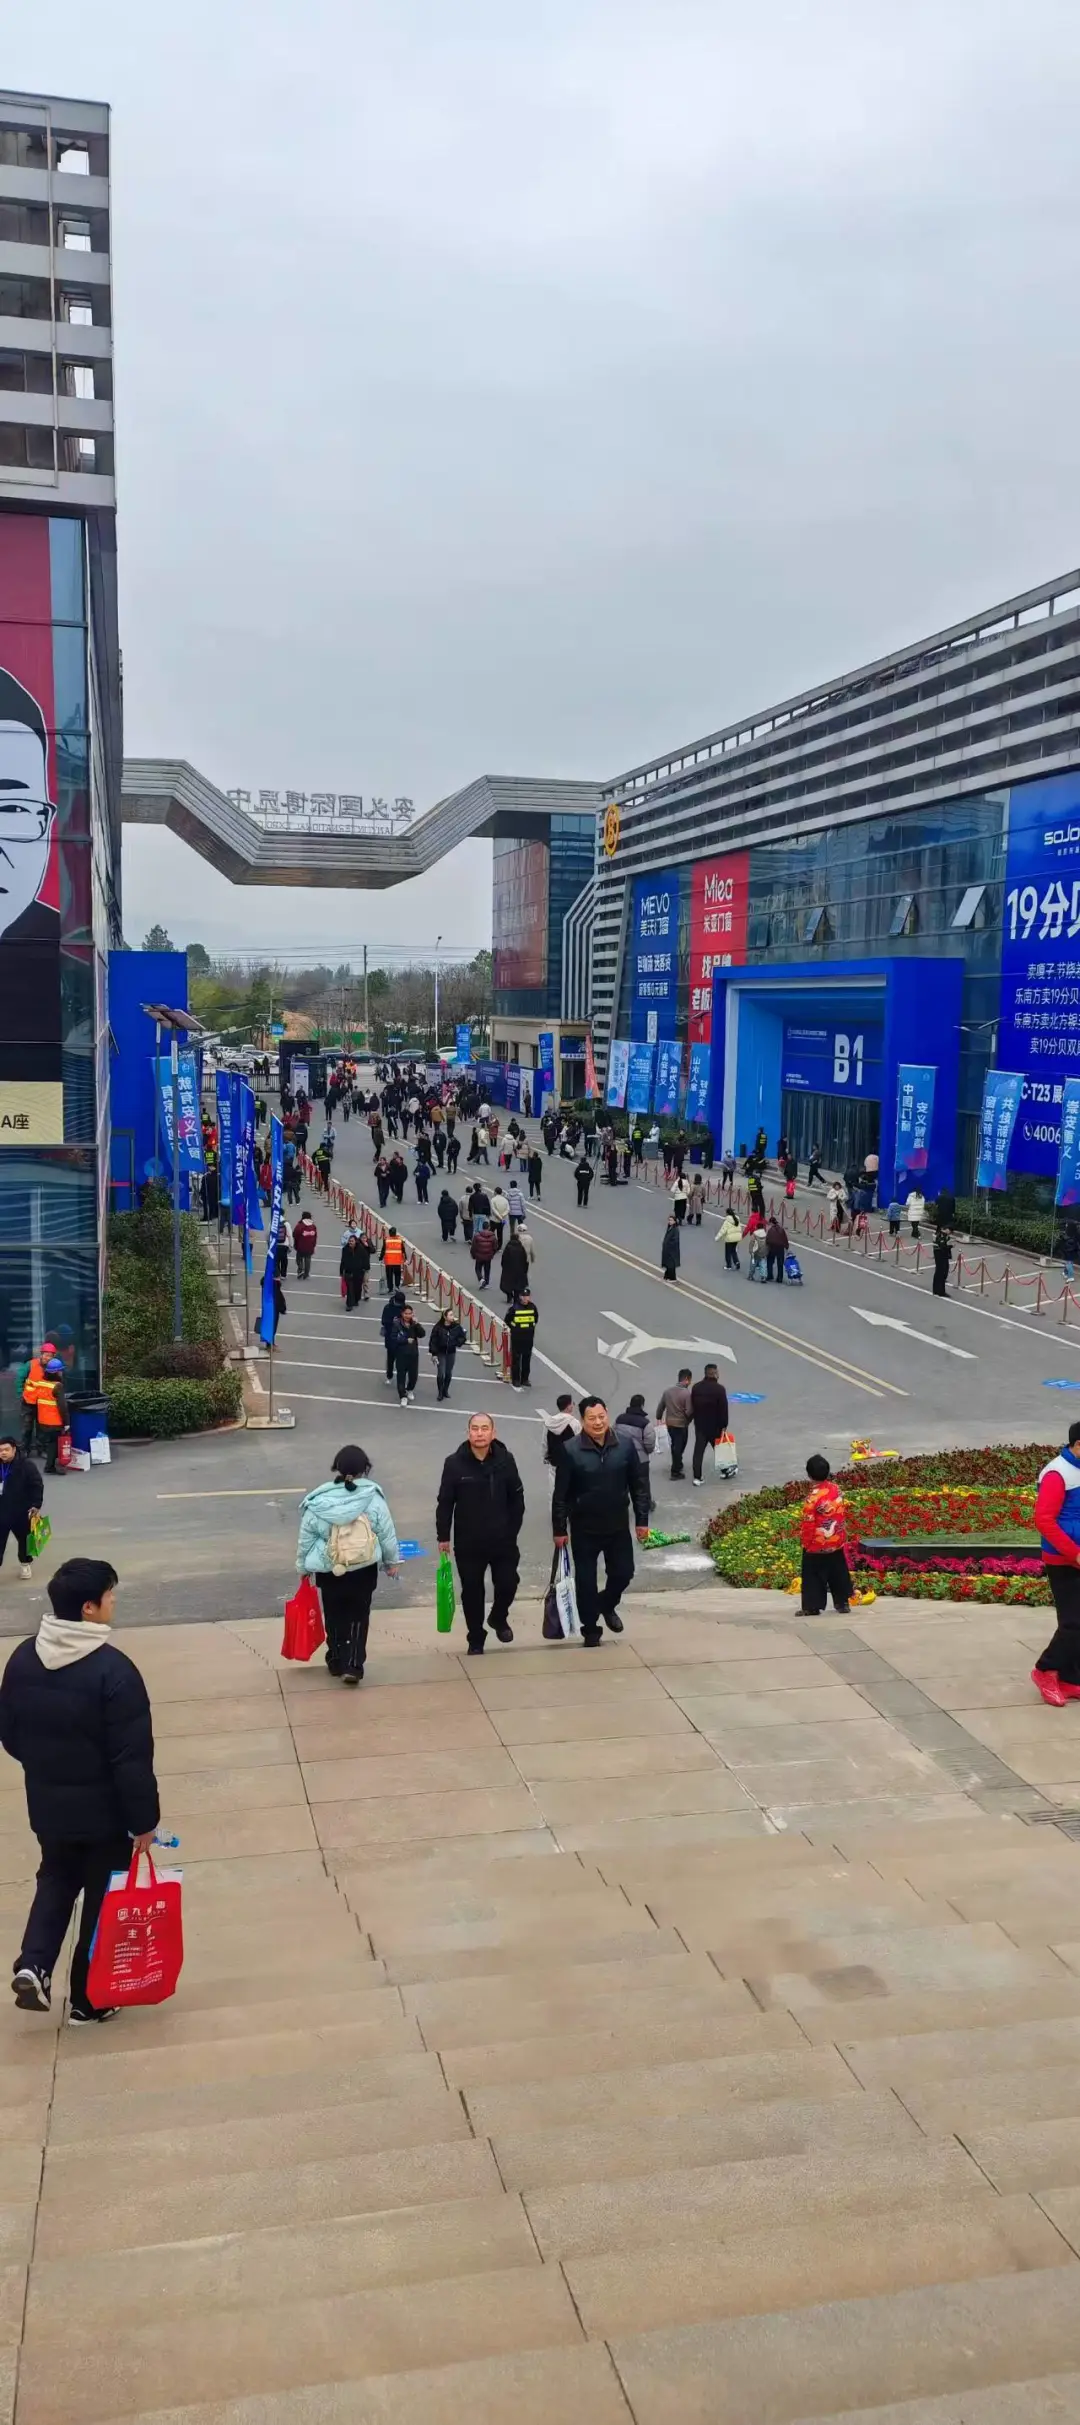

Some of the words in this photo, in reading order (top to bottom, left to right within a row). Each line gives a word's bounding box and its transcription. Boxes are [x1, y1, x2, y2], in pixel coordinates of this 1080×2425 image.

[641, 893, 670, 916] MEVO
[703, 911, 732, 933] 米亚门窗
[692, 987, 712, 1011] 老板
[1014, 987, 1080, 1005] 乐南方卖19分贝
[833, 1034, 863, 1086] B1
[1, 1114, 30, 1130] A座
